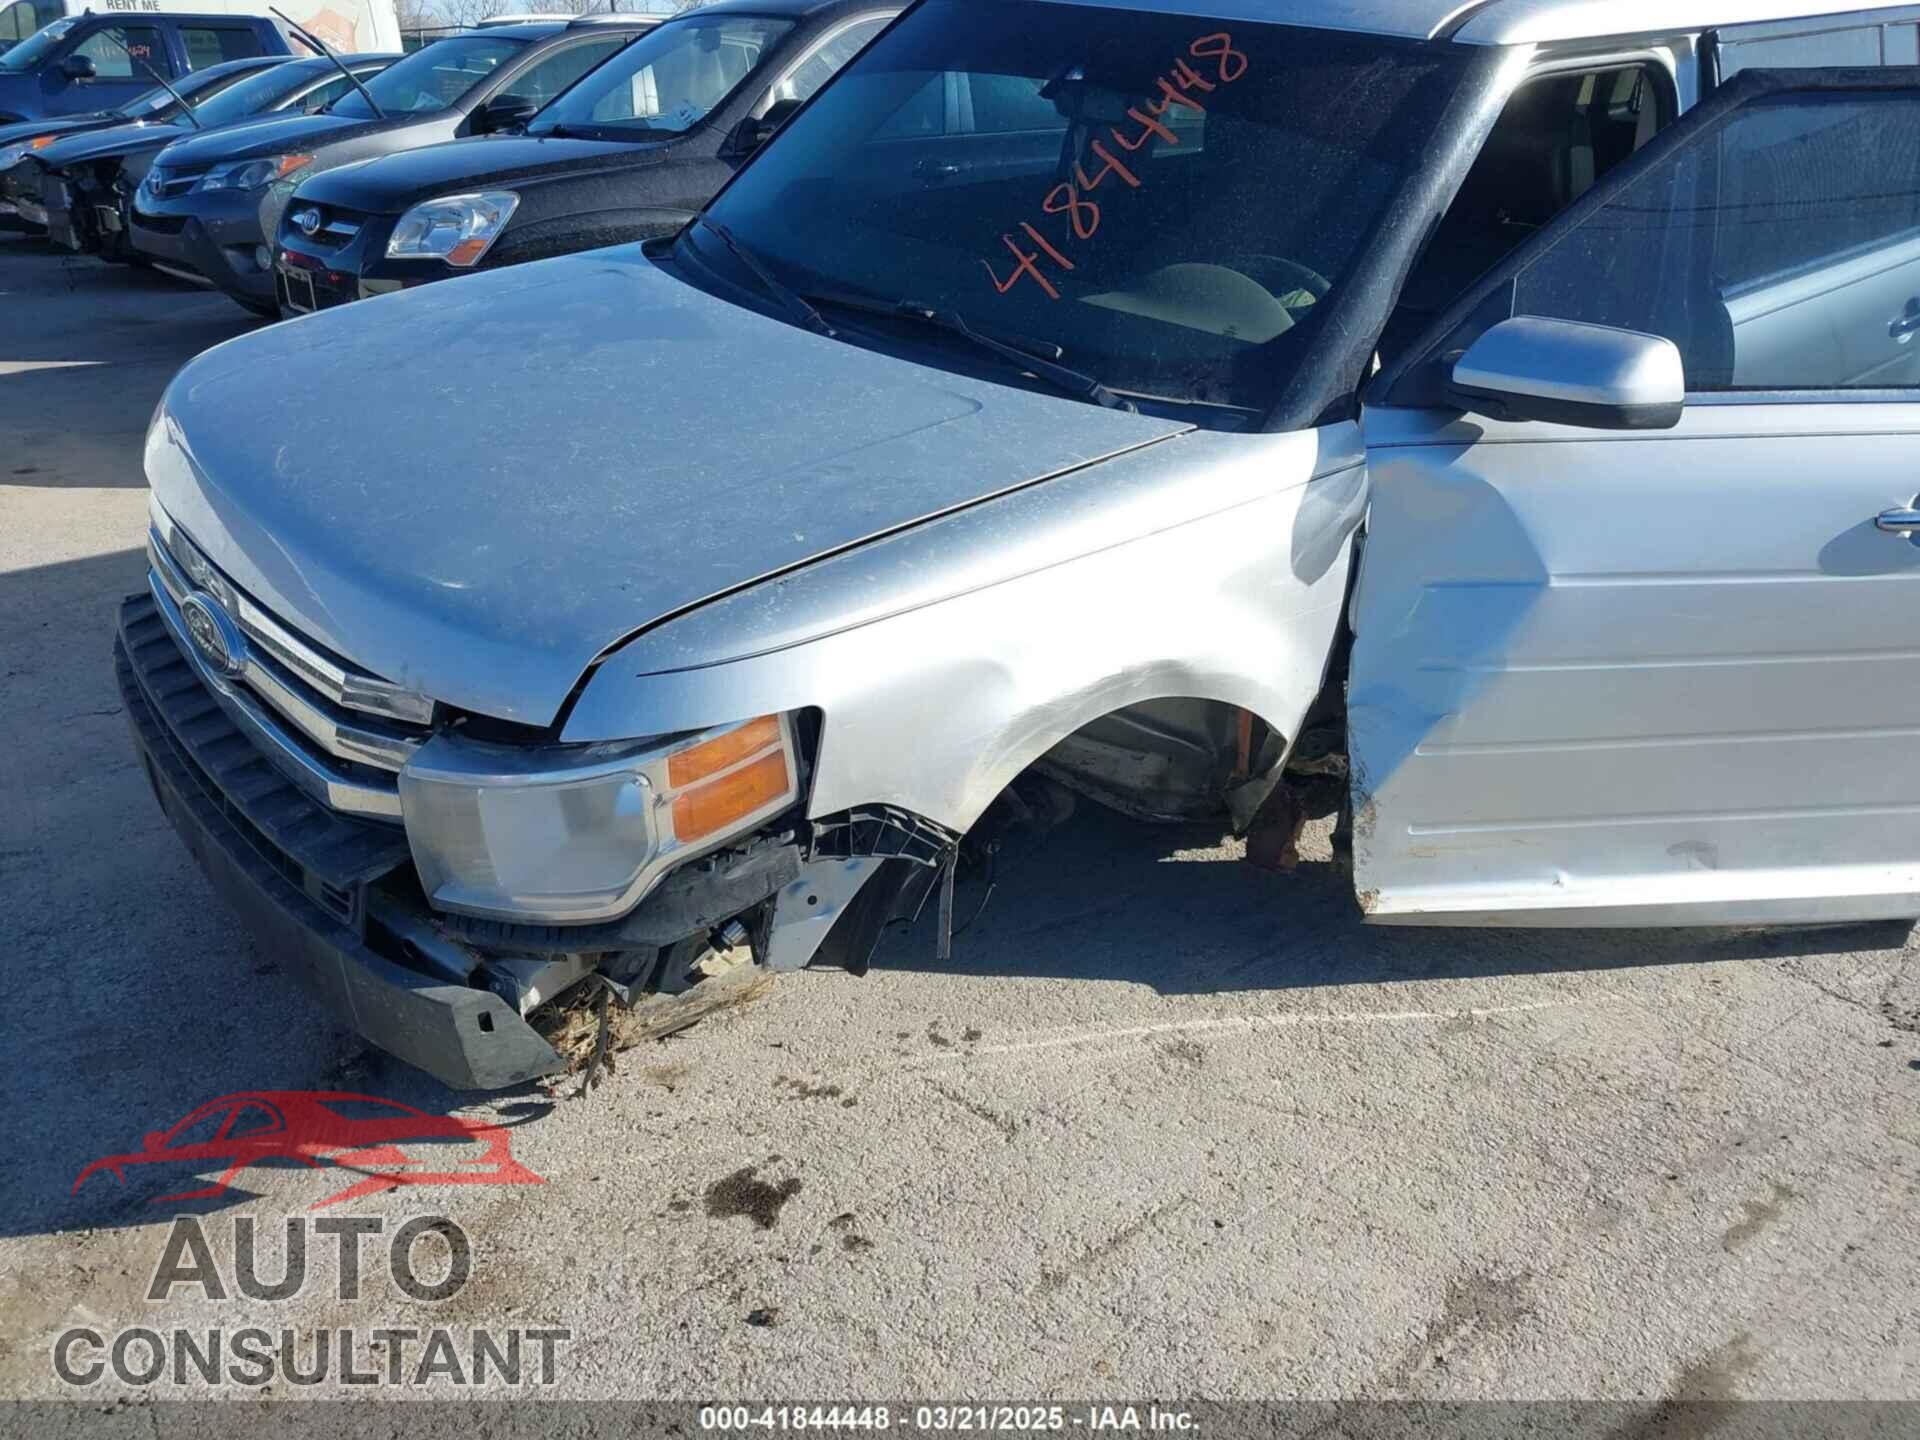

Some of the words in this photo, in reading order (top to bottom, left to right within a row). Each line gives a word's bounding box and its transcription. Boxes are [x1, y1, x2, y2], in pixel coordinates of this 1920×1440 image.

[106, 0, 137, 10] RENT
[142, 0, 161, 11] ME
[981, 32, 1249, 299] 41844448
